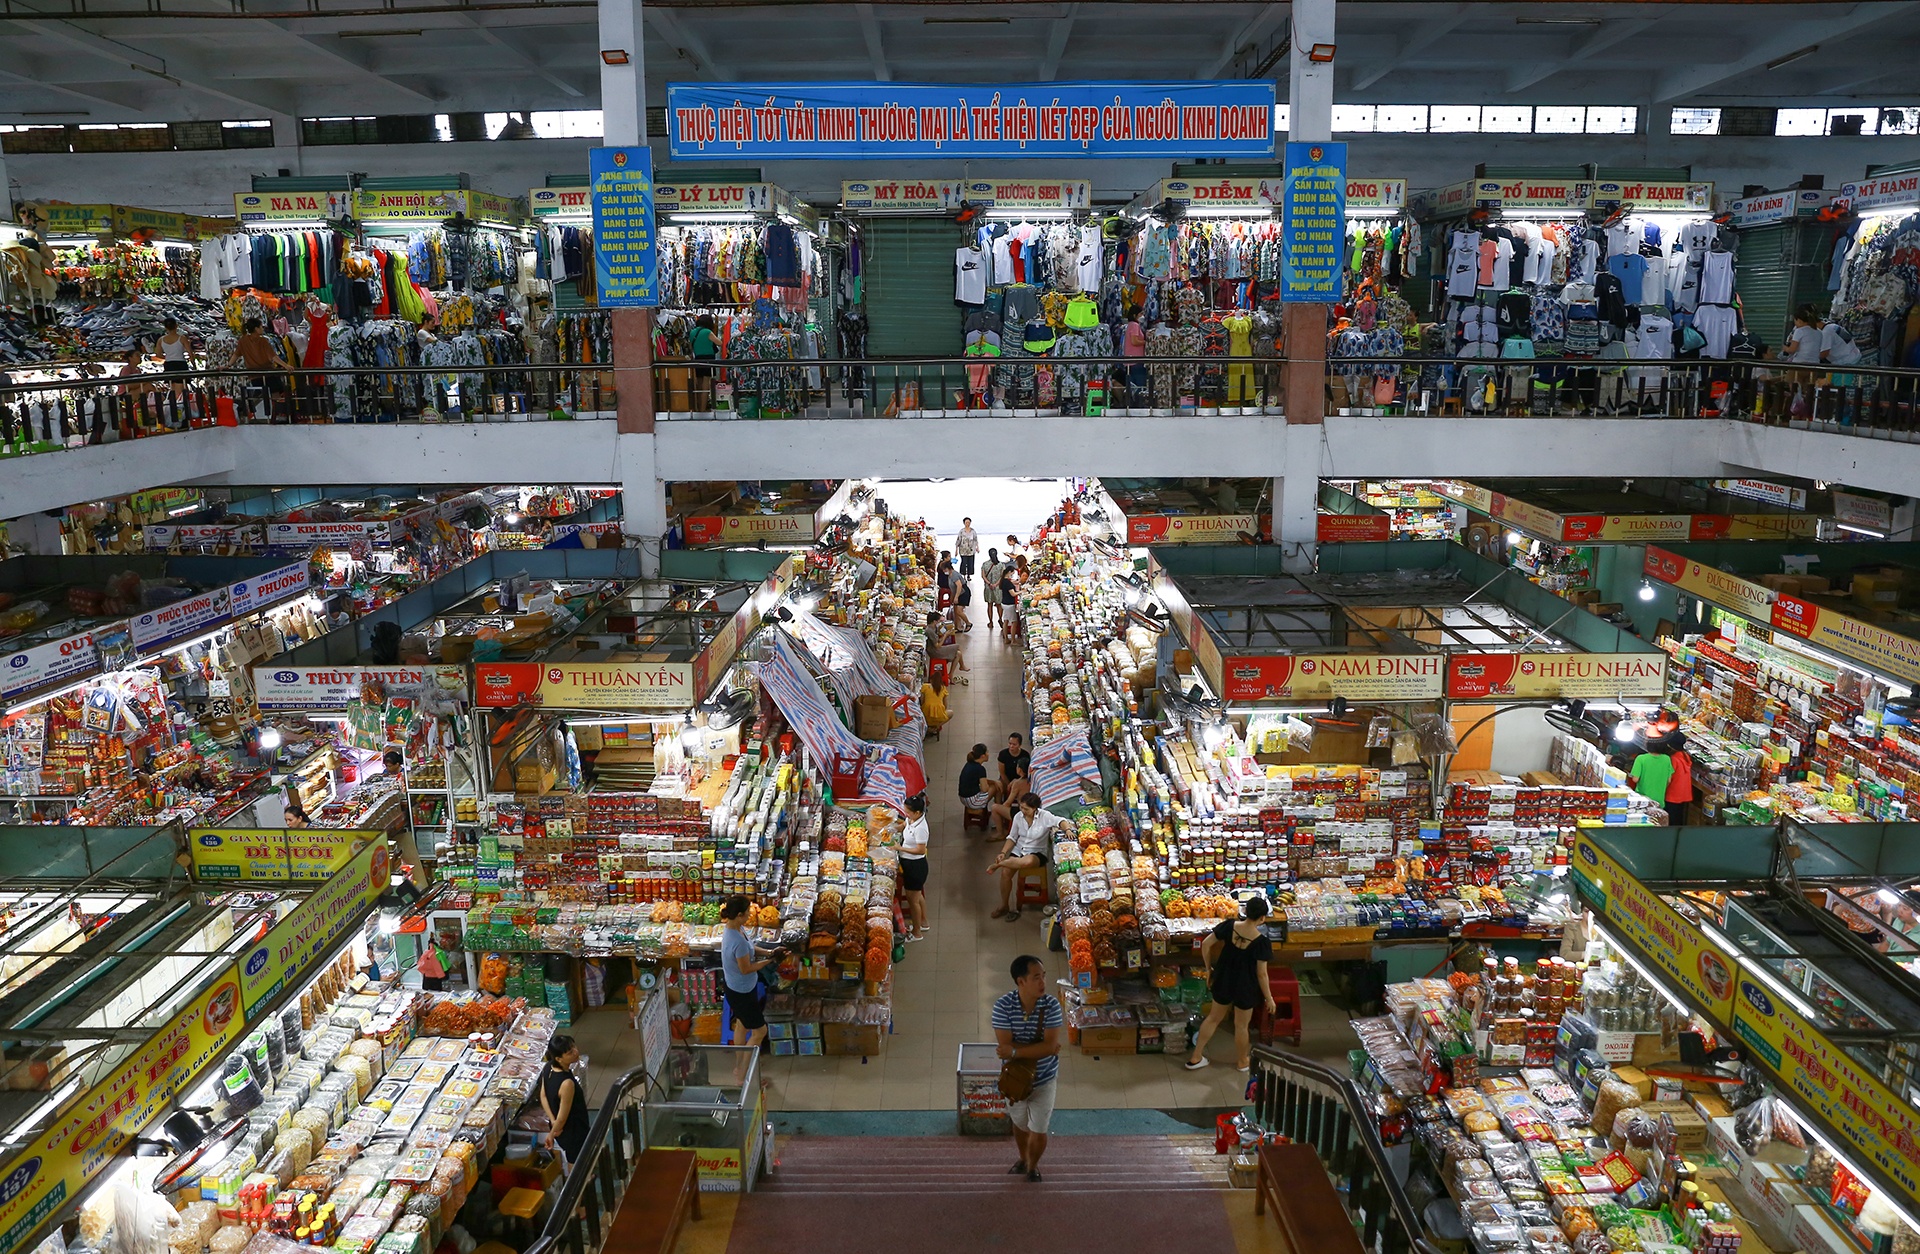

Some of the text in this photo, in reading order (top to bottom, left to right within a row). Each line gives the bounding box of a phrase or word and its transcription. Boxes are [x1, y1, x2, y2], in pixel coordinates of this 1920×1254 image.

[676, 92, 1269, 150] THỰC HIỆN TỐT VĂN MINH THƯƠNG MẠI LÀ THỂ HIỆN NÉT ĐẸP CỦA NGƯỜI KINH DOANH
[596, 184, 612, 194] VẬN
[680, 185, 744, 204] LÝ LỰU
[874, 182, 938, 199] MỸ HÒA
[996, 184, 1061, 199] HƯƠNG SEN
[1194, 181, 1253, 199] DIỄM
[1502, 181, 1566, 198] TỐ MINH
[1623, 184, 1684, 202] MỸ HẠNH
[1859, 178, 1918, 197] MỸ HẠNH
[380, 193, 425, 208] ÁNH HỘI
[621, 194, 643, 203] XUẤT
[1293, 192, 1336, 202] BUÔN BÁN
[1447, 189, 1462, 203] MINH
[271, 197, 318, 210] NA NA
[1293, 205, 1315, 215] HÀNG
[1764, 197, 1783, 210] BÌNH
[602, 206, 645, 216] BUÔN BÁN
[629, 217, 644, 226] GIẢ
[1292, 218, 1336, 228] MÀ KHÔNG
[601, 241, 649, 251] HÀNG NHẬP
[1292, 243, 1314, 253] HÀNG
[612, 253, 639, 264] LẬU LÀ
[1302, 256, 1324, 266] HÀNH
[1327, 258, 1335, 266] VI
[1295, 270, 1303, 278] VI
[610, 277, 645, 286] VI PHẠM
[630, 289, 649, 298] LUẬT
[1764, 484, 1785, 494] TRÚC
[297, 525, 317, 534] KIM
[747, 516, 799, 530] THU HÀ
[1188, 516, 1251, 531] THUẬN VỸ
[1628, 518, 1683, 529] TUẤN ĐÀO
[257, 571, 304, 597] PHƯƠNG
[1706, 571, 1765, 604] ĐỨC THƯƠNG
[157, 598, 211, 624] PHÚC TƯỜNG
[1786, 600, 1804, 615] 26
[1840, 618, 1920, 657] THU TRAN
[15, 656, 25, 666] 64
[1302, 661, 1314, 670] 36
[1320, 658, 1438, 678] NAM ĐỊNH
[1523, 662, 1533, 671] 35
[1539, 656, 1662, 677] HIẾU NHÂN
[279, 673, 294, 682] 53
[306, 669, 423, 685] THÙY DUYÊN
[550, 670, 561, 679] 52
[568, 665, 684, 690] THUẬN YẾN
[229, 833, 345, 844] GIA VỊ THỰC PHẨM
[244, 844, 333, 859] DÌ NUÔI
[291, 913, 306, 928] GIA
[336, 867, 357, 890] PHẨM
[1601, 860, 1618, 878] GIA
[1664, 913, 1699, 947] PHẨM
[295, 915, 326, 950] NUÔI
[1748, 992, 1767, 1013] 152
[1778, 1011, 1806, 1041] GIA
[1810, 1038, 1828, 1058] VỊ
[1832, 1055, 1882, 1105] THỰC
[1781, 1033, 1839, 1091] DIỆU
[46, 1008, 201, 1152] GIA VỊ THỰC PHẨM
